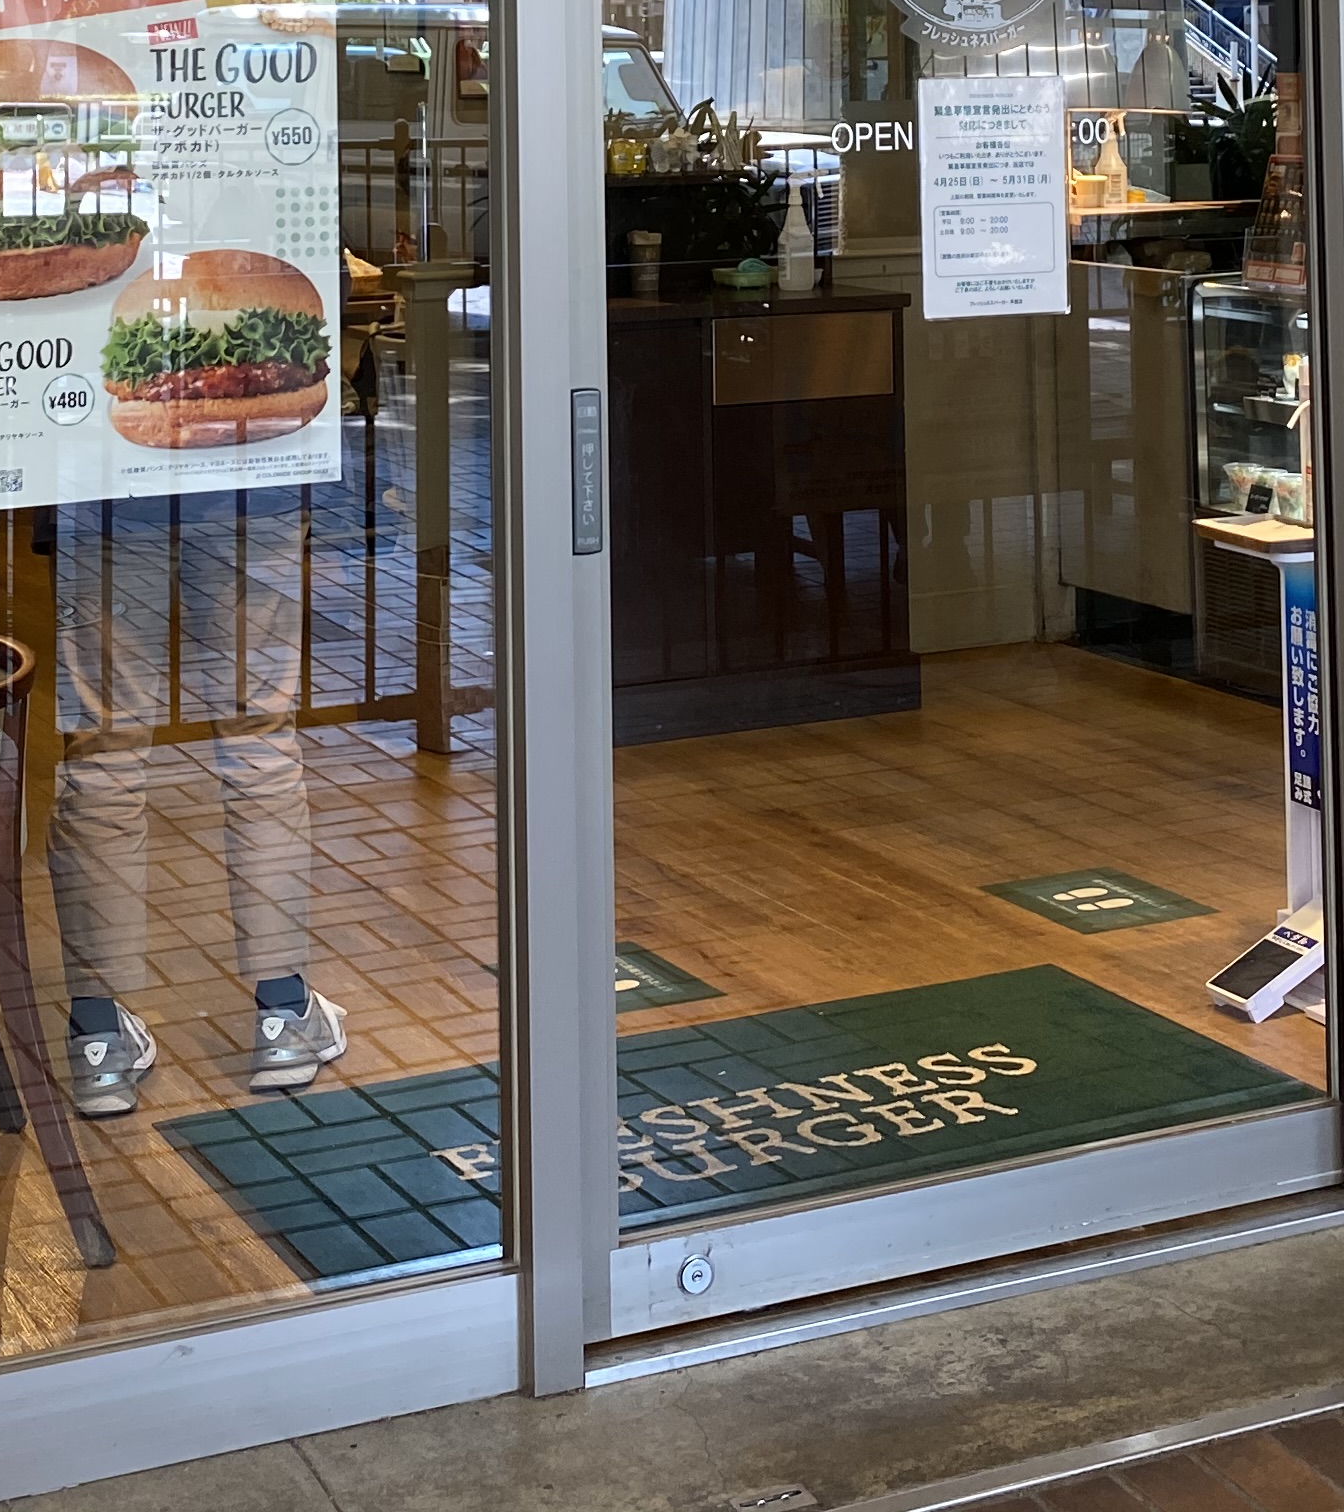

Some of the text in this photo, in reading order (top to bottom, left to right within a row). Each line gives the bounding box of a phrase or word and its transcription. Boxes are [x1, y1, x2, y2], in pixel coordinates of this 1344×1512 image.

[920, 21, 1026, 48] フレッシュネスバーガー
[150, 41, 317, 85] THE GOOD
[151, 91, 245, 120] BURGER
[271, 126, 312, 145] ¥550
[830, 117, 1110, 153] OPEN :00
[49, 391, 87, 409] ¥480
